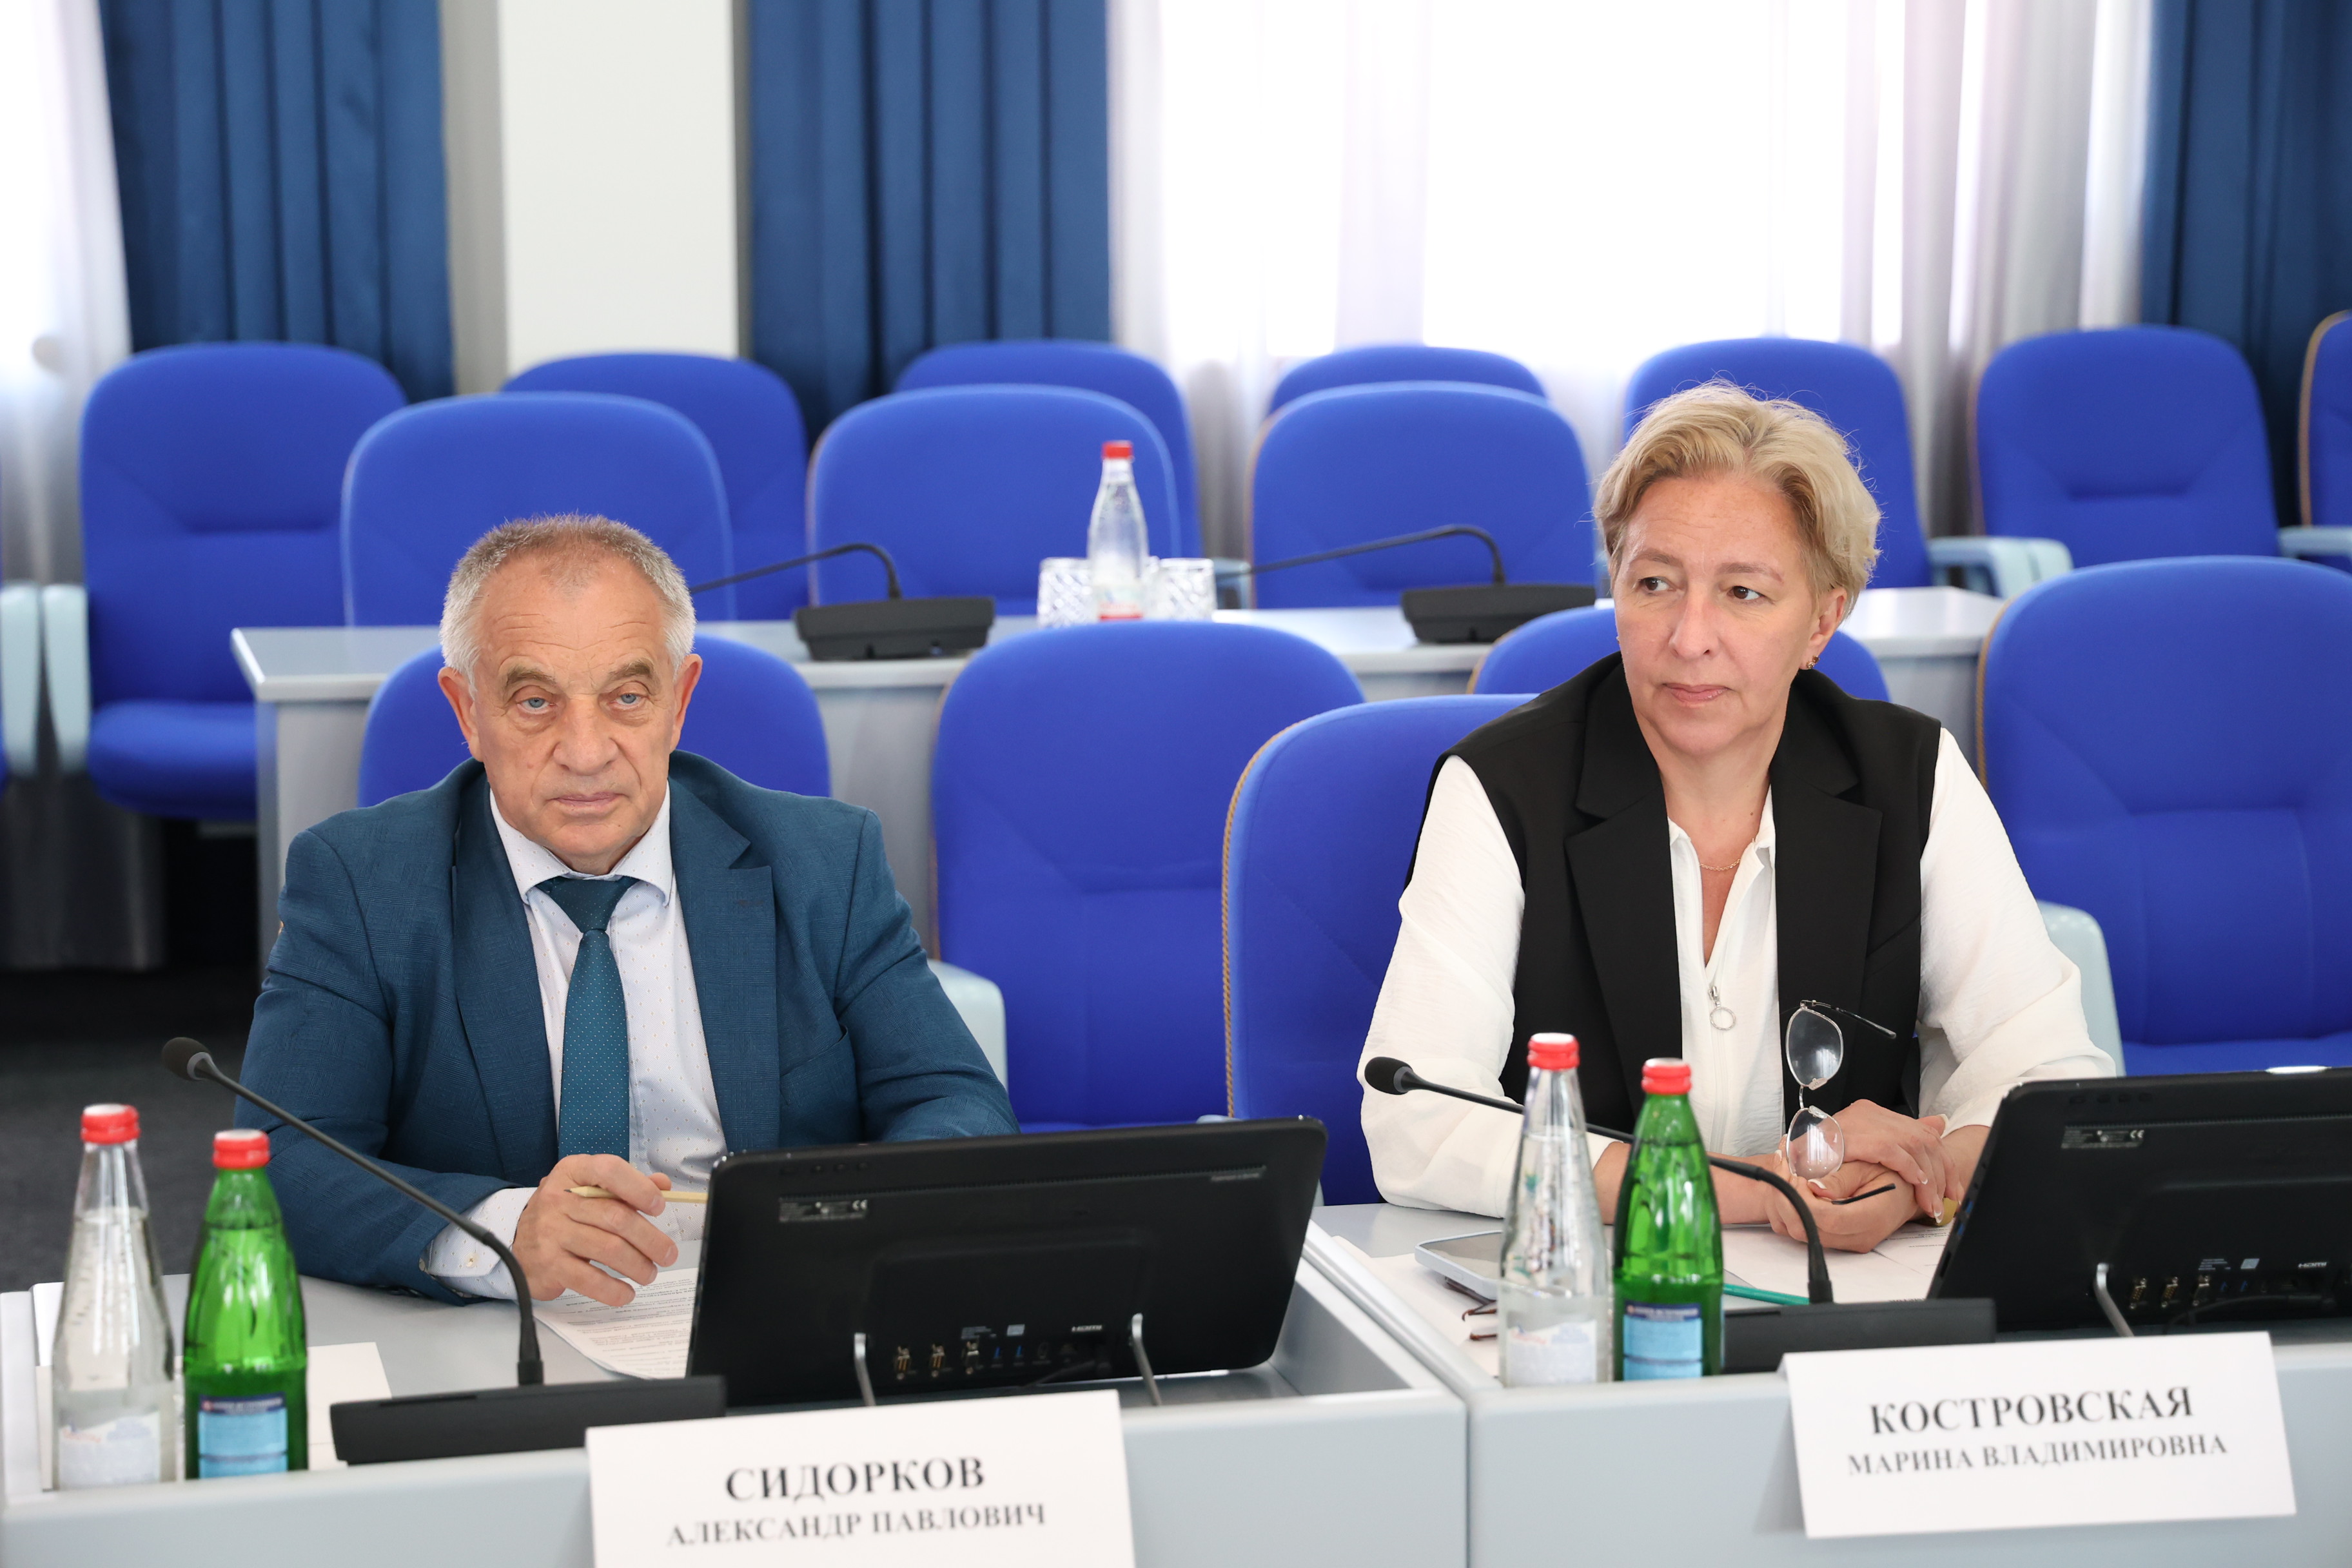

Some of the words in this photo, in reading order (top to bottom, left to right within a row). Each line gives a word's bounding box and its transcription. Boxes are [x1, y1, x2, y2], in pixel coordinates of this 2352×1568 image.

[1869, 1386, 2193, 1435] КОСТРОВСКАЯ
[1848, 1447, 1974, 1476] МАРИНА
[1983, 1434, 2228, 1467] ВЛАДИМИРОВНА
[725, 1456, 985, 1503] СИДОРКОВ
[667, 1513, 862, 1547] АЛЕКСАНДР
[872, 1503, 1046, 1534] ПАВЛОВИЧ
